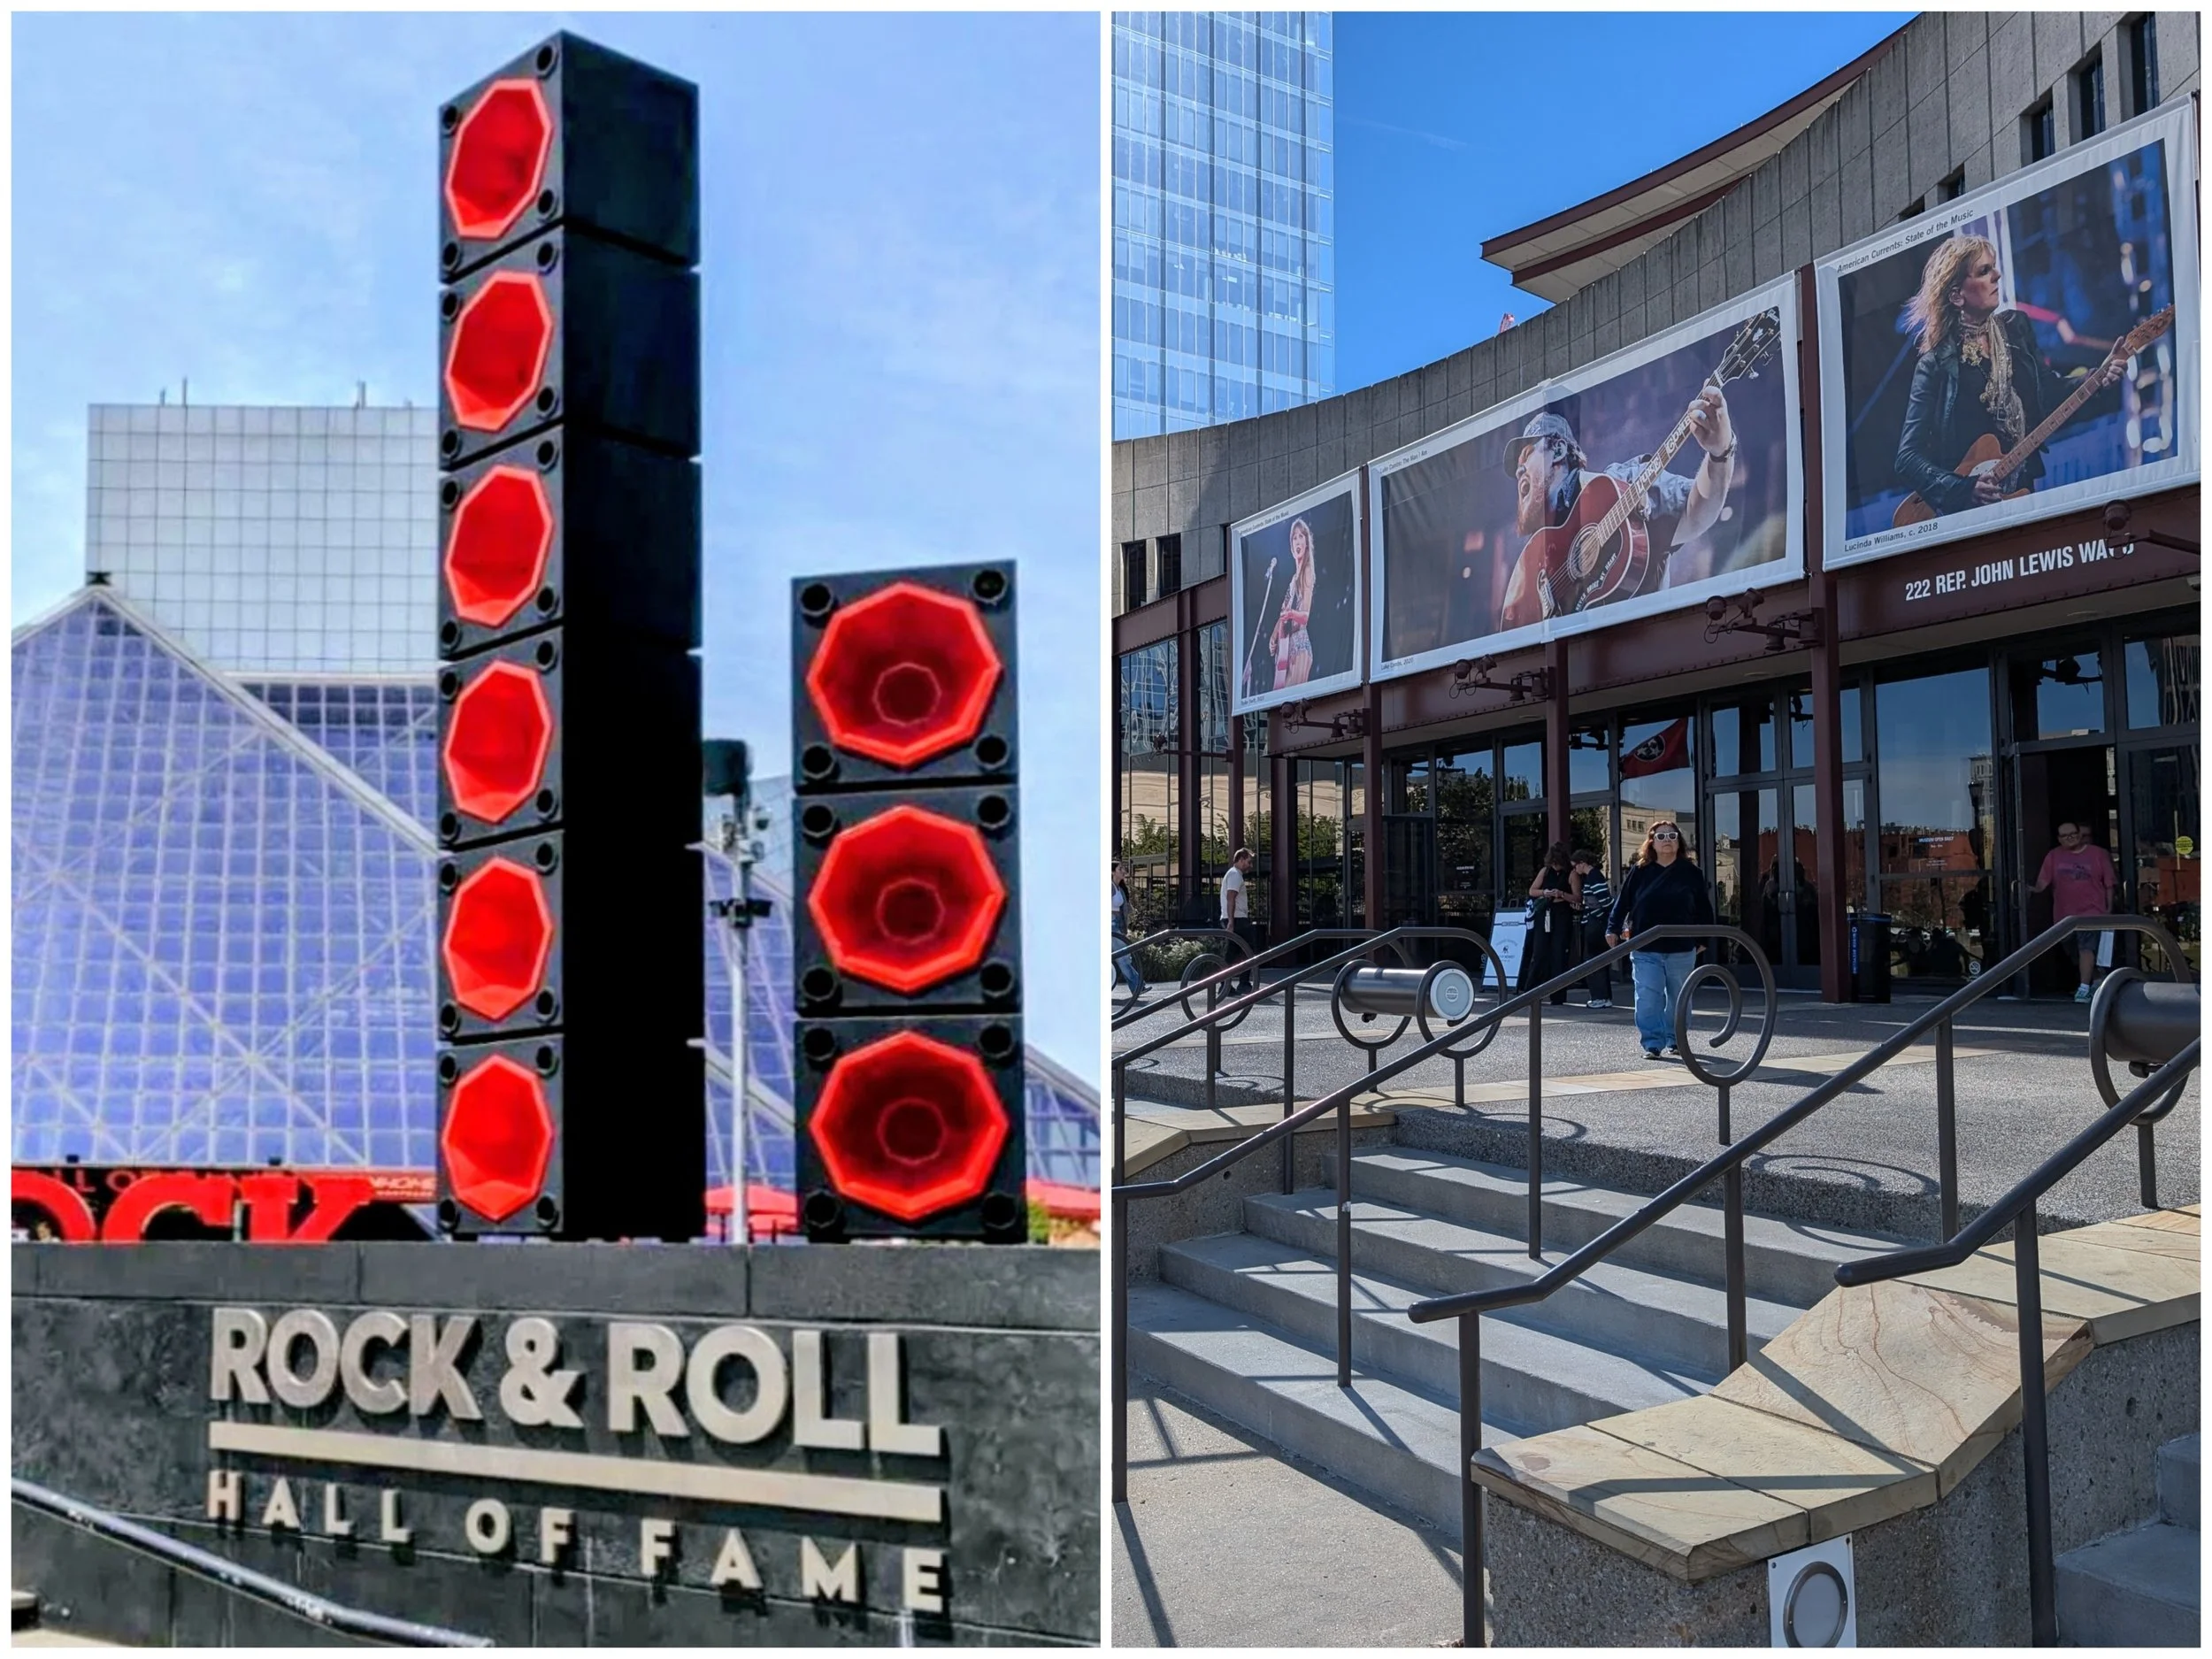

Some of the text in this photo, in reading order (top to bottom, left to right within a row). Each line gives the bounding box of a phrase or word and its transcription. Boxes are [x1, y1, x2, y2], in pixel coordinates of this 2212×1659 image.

[1837, 210, 1974, 273] American Currents: State of the Music
[1845, 539, 1872, 552] Lucinda
[1874, 531, 1907, 545] Williams,
[1917, 522, 1939, 534] 2018
[1905, 579, 1931, 601] 222
[1936, 570, 1967, 595] REP.
[1971, 559, 2014, 588] JOHN
[2019, 545, 2074, 577] LEWIS
[211, 1308, 941, 1456] ROCK & ROLL
[208, 1469, 942, 1613] HALL OF FAME
